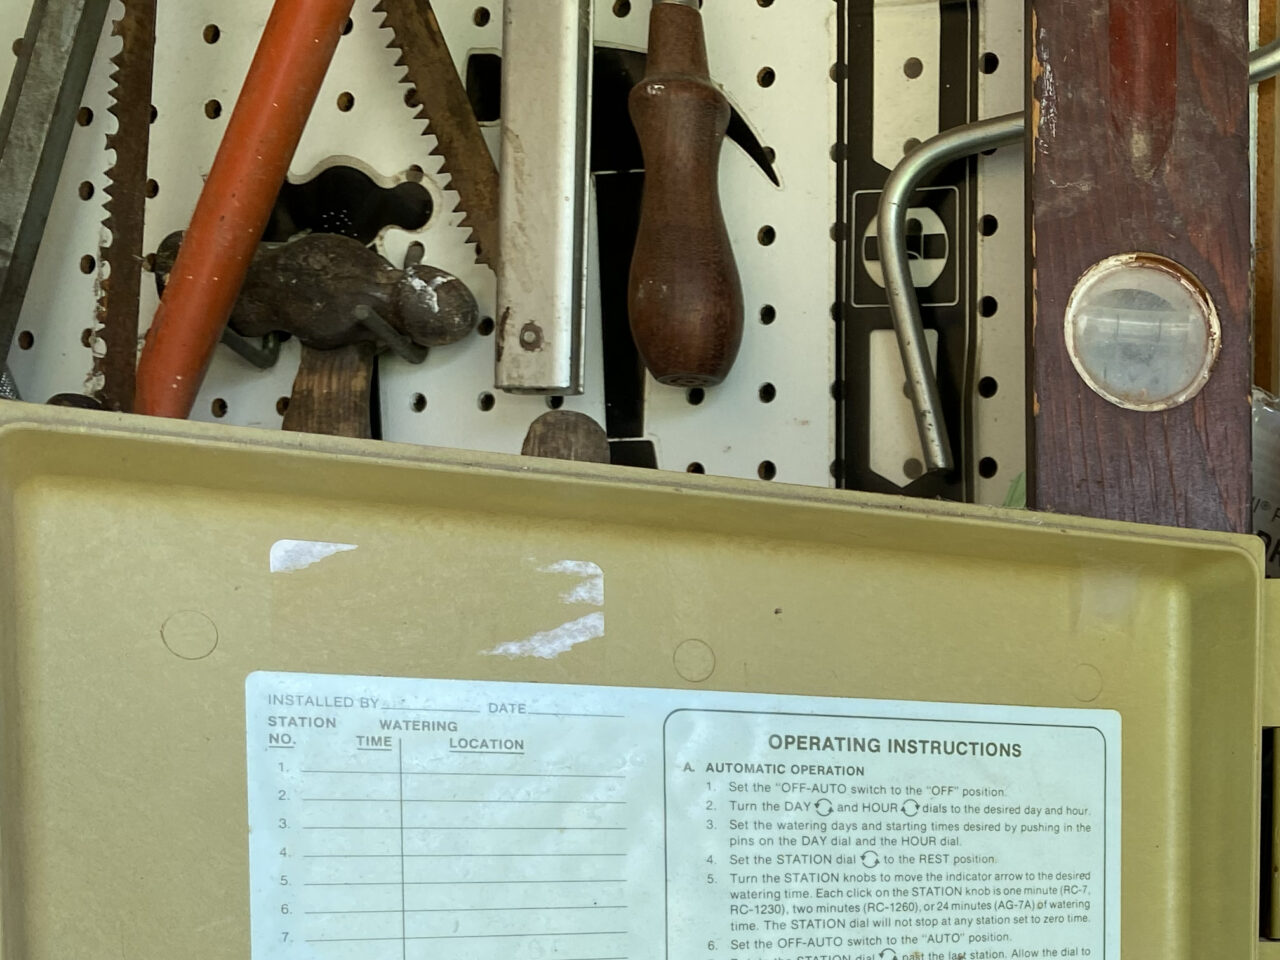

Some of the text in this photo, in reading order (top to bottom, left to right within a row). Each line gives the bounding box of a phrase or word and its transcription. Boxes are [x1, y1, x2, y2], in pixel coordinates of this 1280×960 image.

[268, 693, 379, 709] INSTALLED BY
[487, 702, 526, 714] DATE
[267, 715, 336, 728] STATION
[378, 719, 458, 732] WATERING
[268, 732, 296, 747] NO.
[355, 735, 392, 749] TIME
[449, 737, 524, 750] LOCATION
[768, 733, 1022, 758] OPERATING INSTRUCTIONS
[705, 762, 864, 776] AUTOMATIC OPERATION
[728, 780, 1007, 798] Set the "OFF-AUTO switch to the "OFF" position.
[729, 853, 856, 865] Set the STATION dial
[883, 853, 994, 866] to the REST position.
